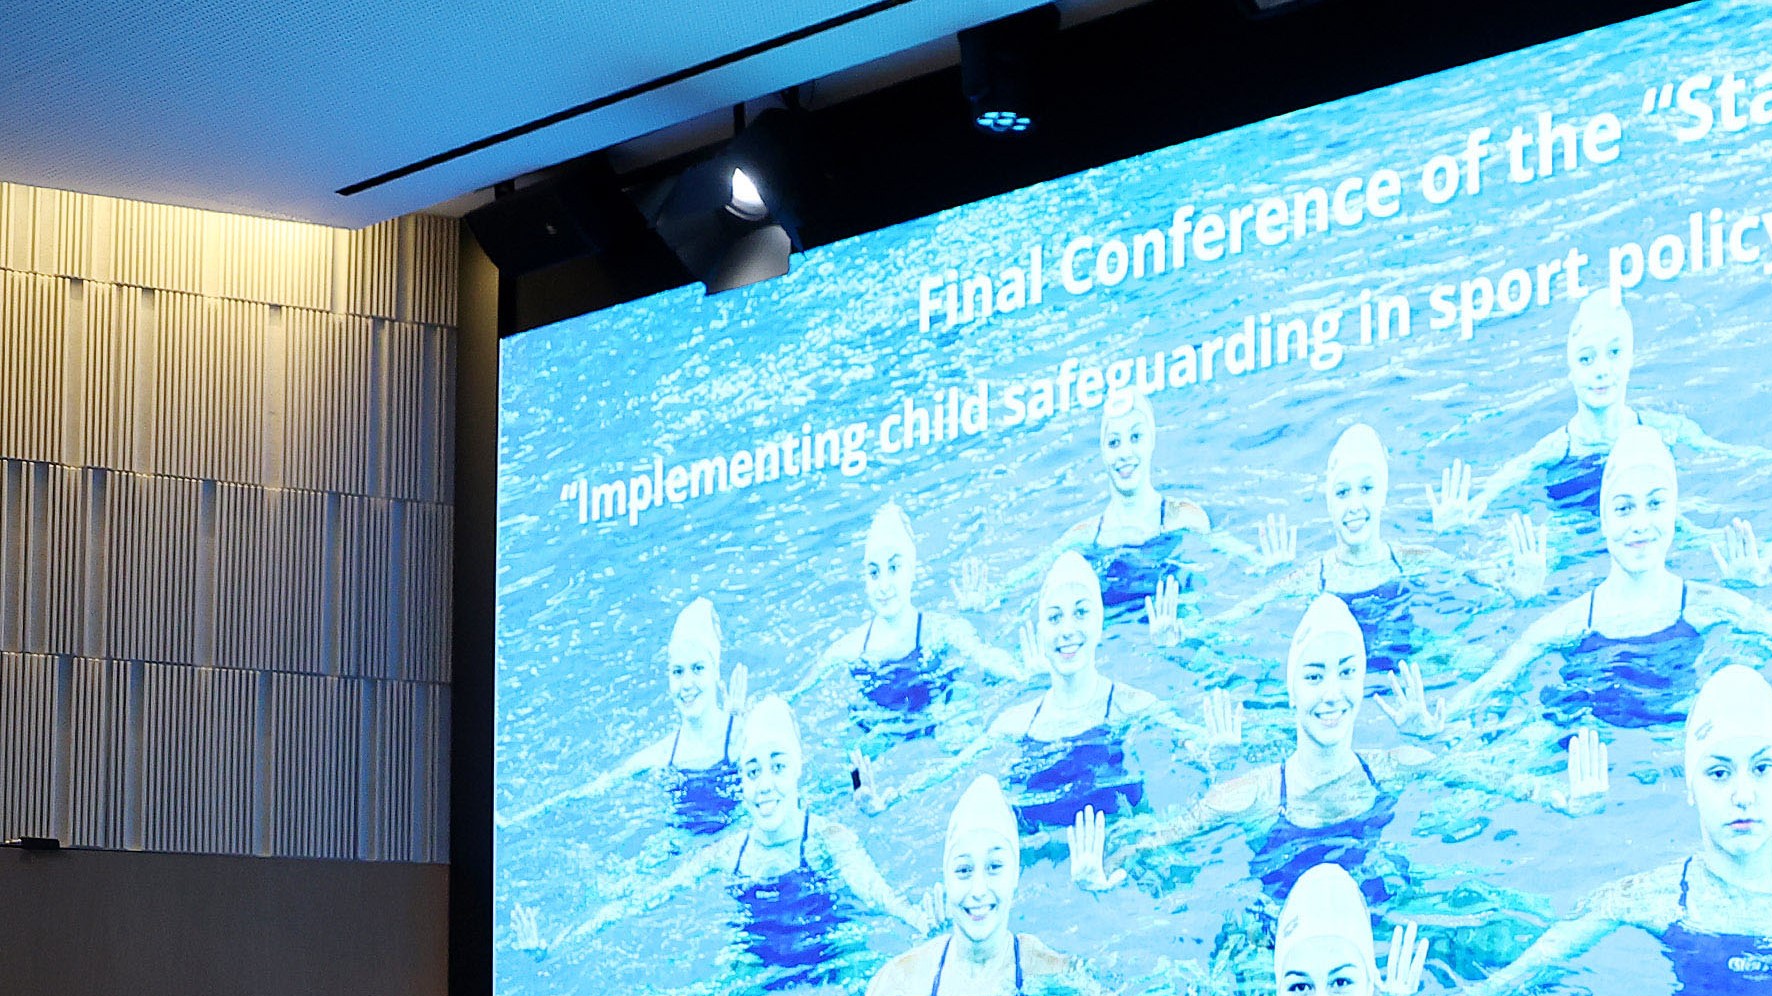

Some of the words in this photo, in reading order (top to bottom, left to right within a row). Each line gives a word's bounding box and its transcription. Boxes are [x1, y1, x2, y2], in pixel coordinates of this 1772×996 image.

[919, 245, 1042, 332] Final
[1060, 169, 1401, 295] Conference
[1421, 128, 1490, 204] of
[1508, 111, 1623, 184] the
[560, 422, 869, 527] “Implementing
[879, 379, 990, 454] child
[999, 310, 1345, 419] safeguarding
[1359, 289, 1411, 345] in
[1428, 247, 1590, 341] sport
